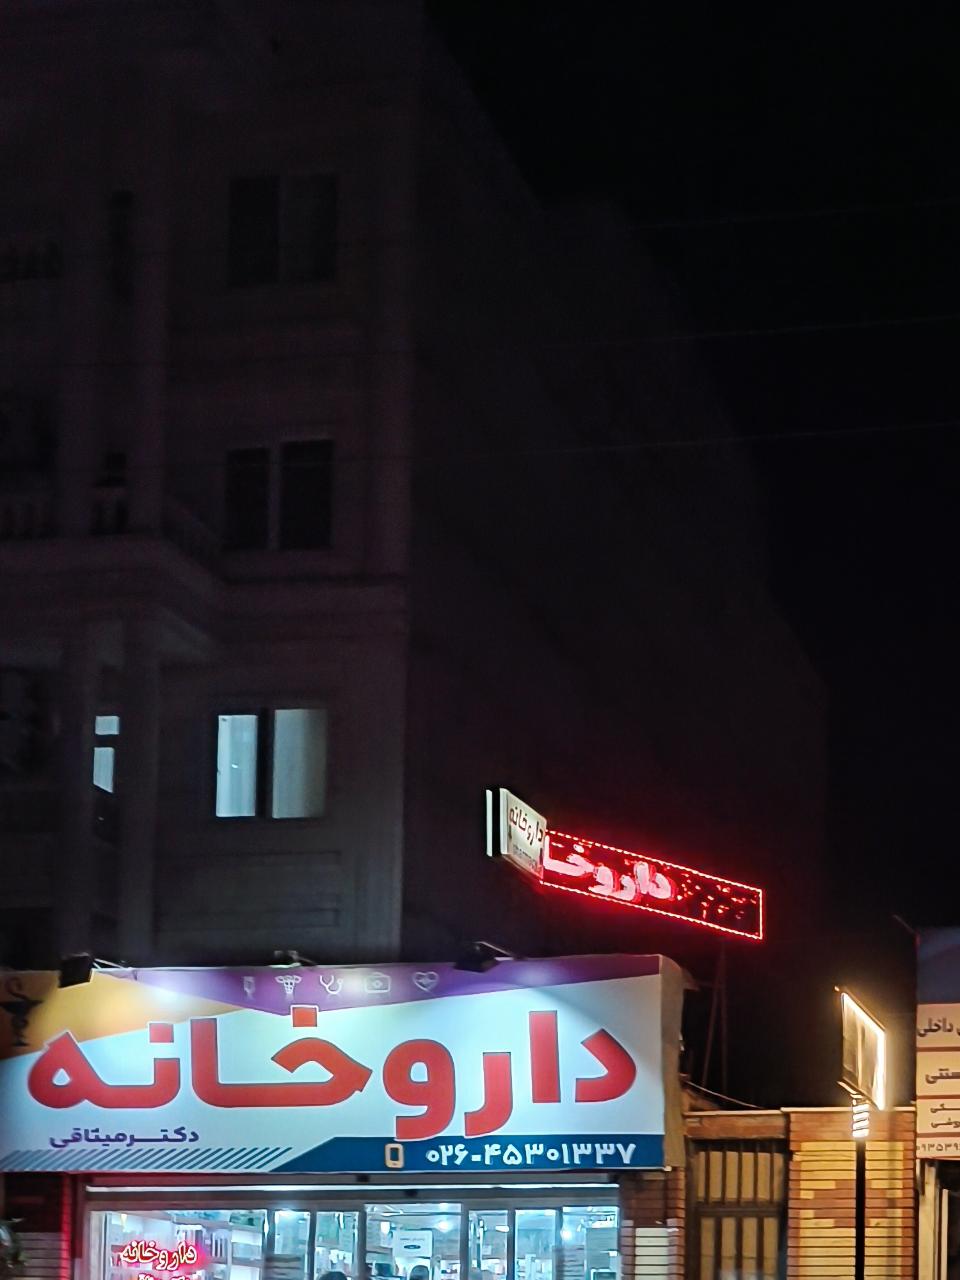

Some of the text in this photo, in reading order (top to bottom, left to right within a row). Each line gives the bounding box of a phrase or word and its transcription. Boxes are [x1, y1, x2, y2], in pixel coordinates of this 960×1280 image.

[508, 805, 545, 846] داروخانه
[917, 1016, 953, 1037] داخلی
[27, 1005, 637, 1140] داروخانه
[120, 1240, 198, 1271] داروخانه
